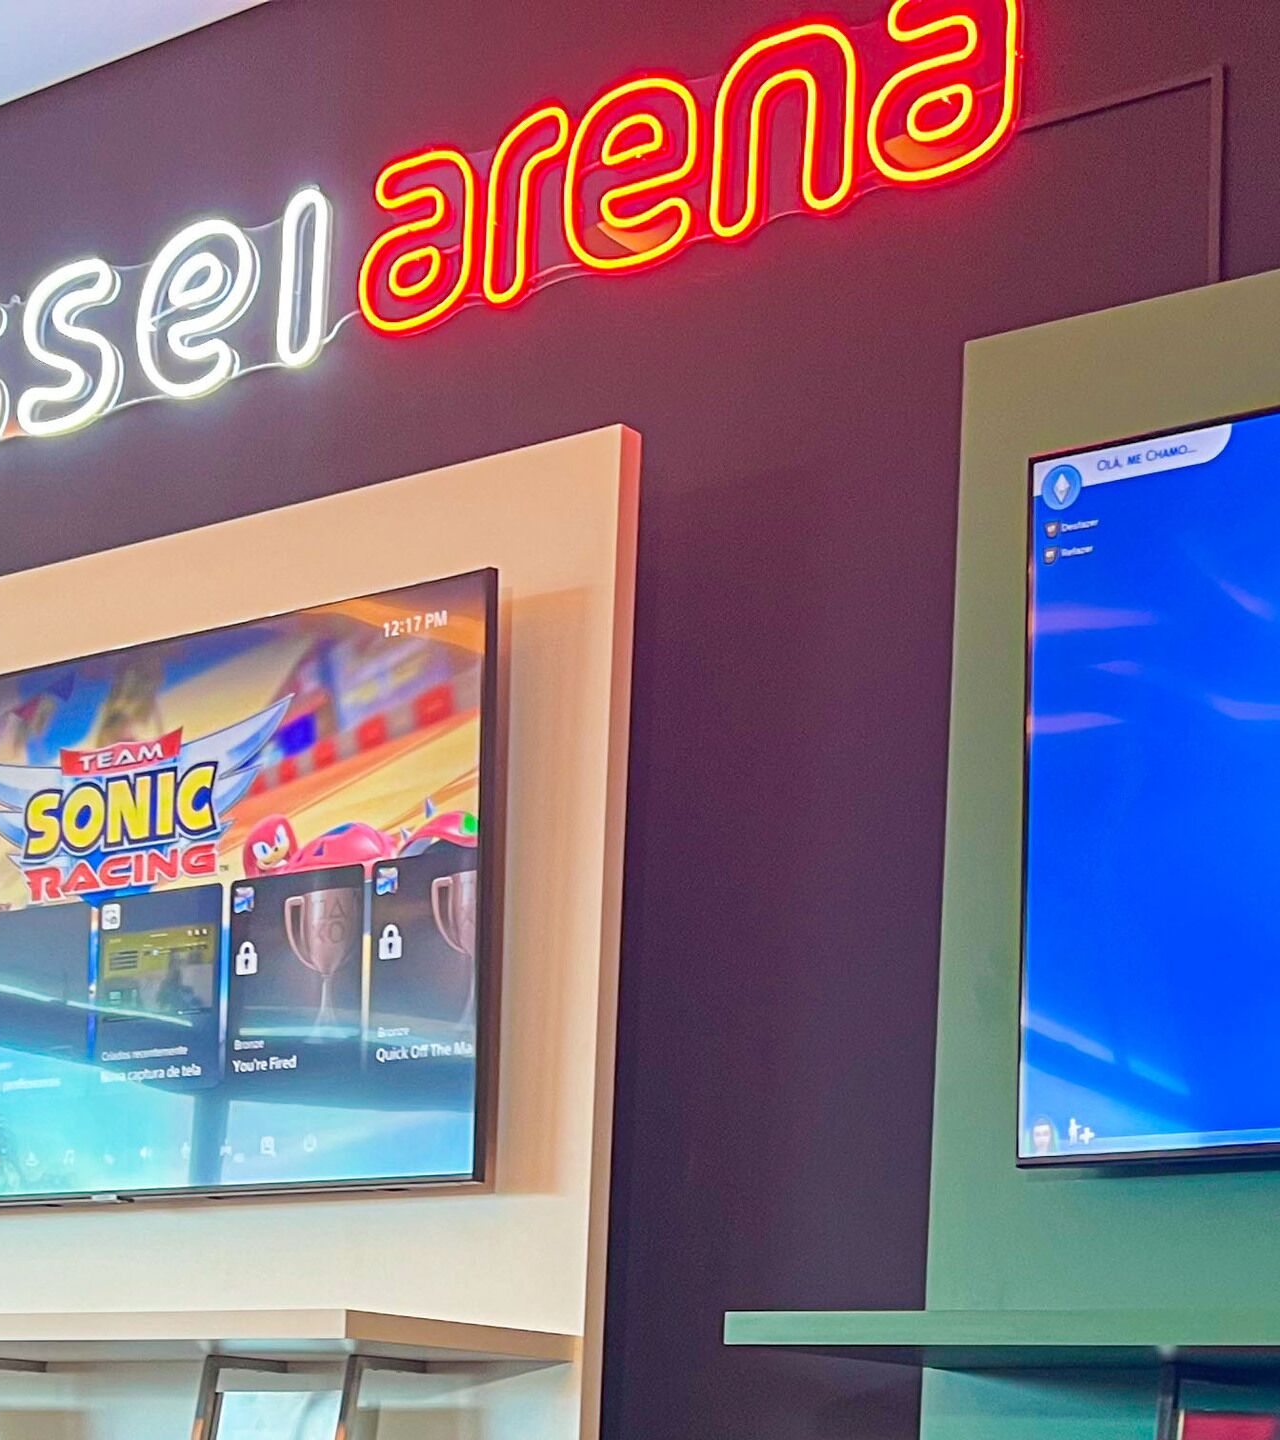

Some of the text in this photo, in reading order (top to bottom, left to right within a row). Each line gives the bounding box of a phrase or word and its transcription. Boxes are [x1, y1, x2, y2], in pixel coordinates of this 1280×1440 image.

[358, 0, 1020, 331] arena
[383, 609, 448, 638] 12:17 PM
[79, 742, 165, 772] TEAM
[24, 762, 218, 860] SONIC
[23, 842, 217, 902] RACING
[232, 1054, 298, 1074] You're Fired
[375, 1045, 409, 1064] Quick
[410, 1043, 429, 1060] Off
[430, 1042, 453, 1057] The
[128, 1066, 165, 1083] captura
[166, 1064, 180, 1078] de
[181, 1062, 202, 1077] tela
